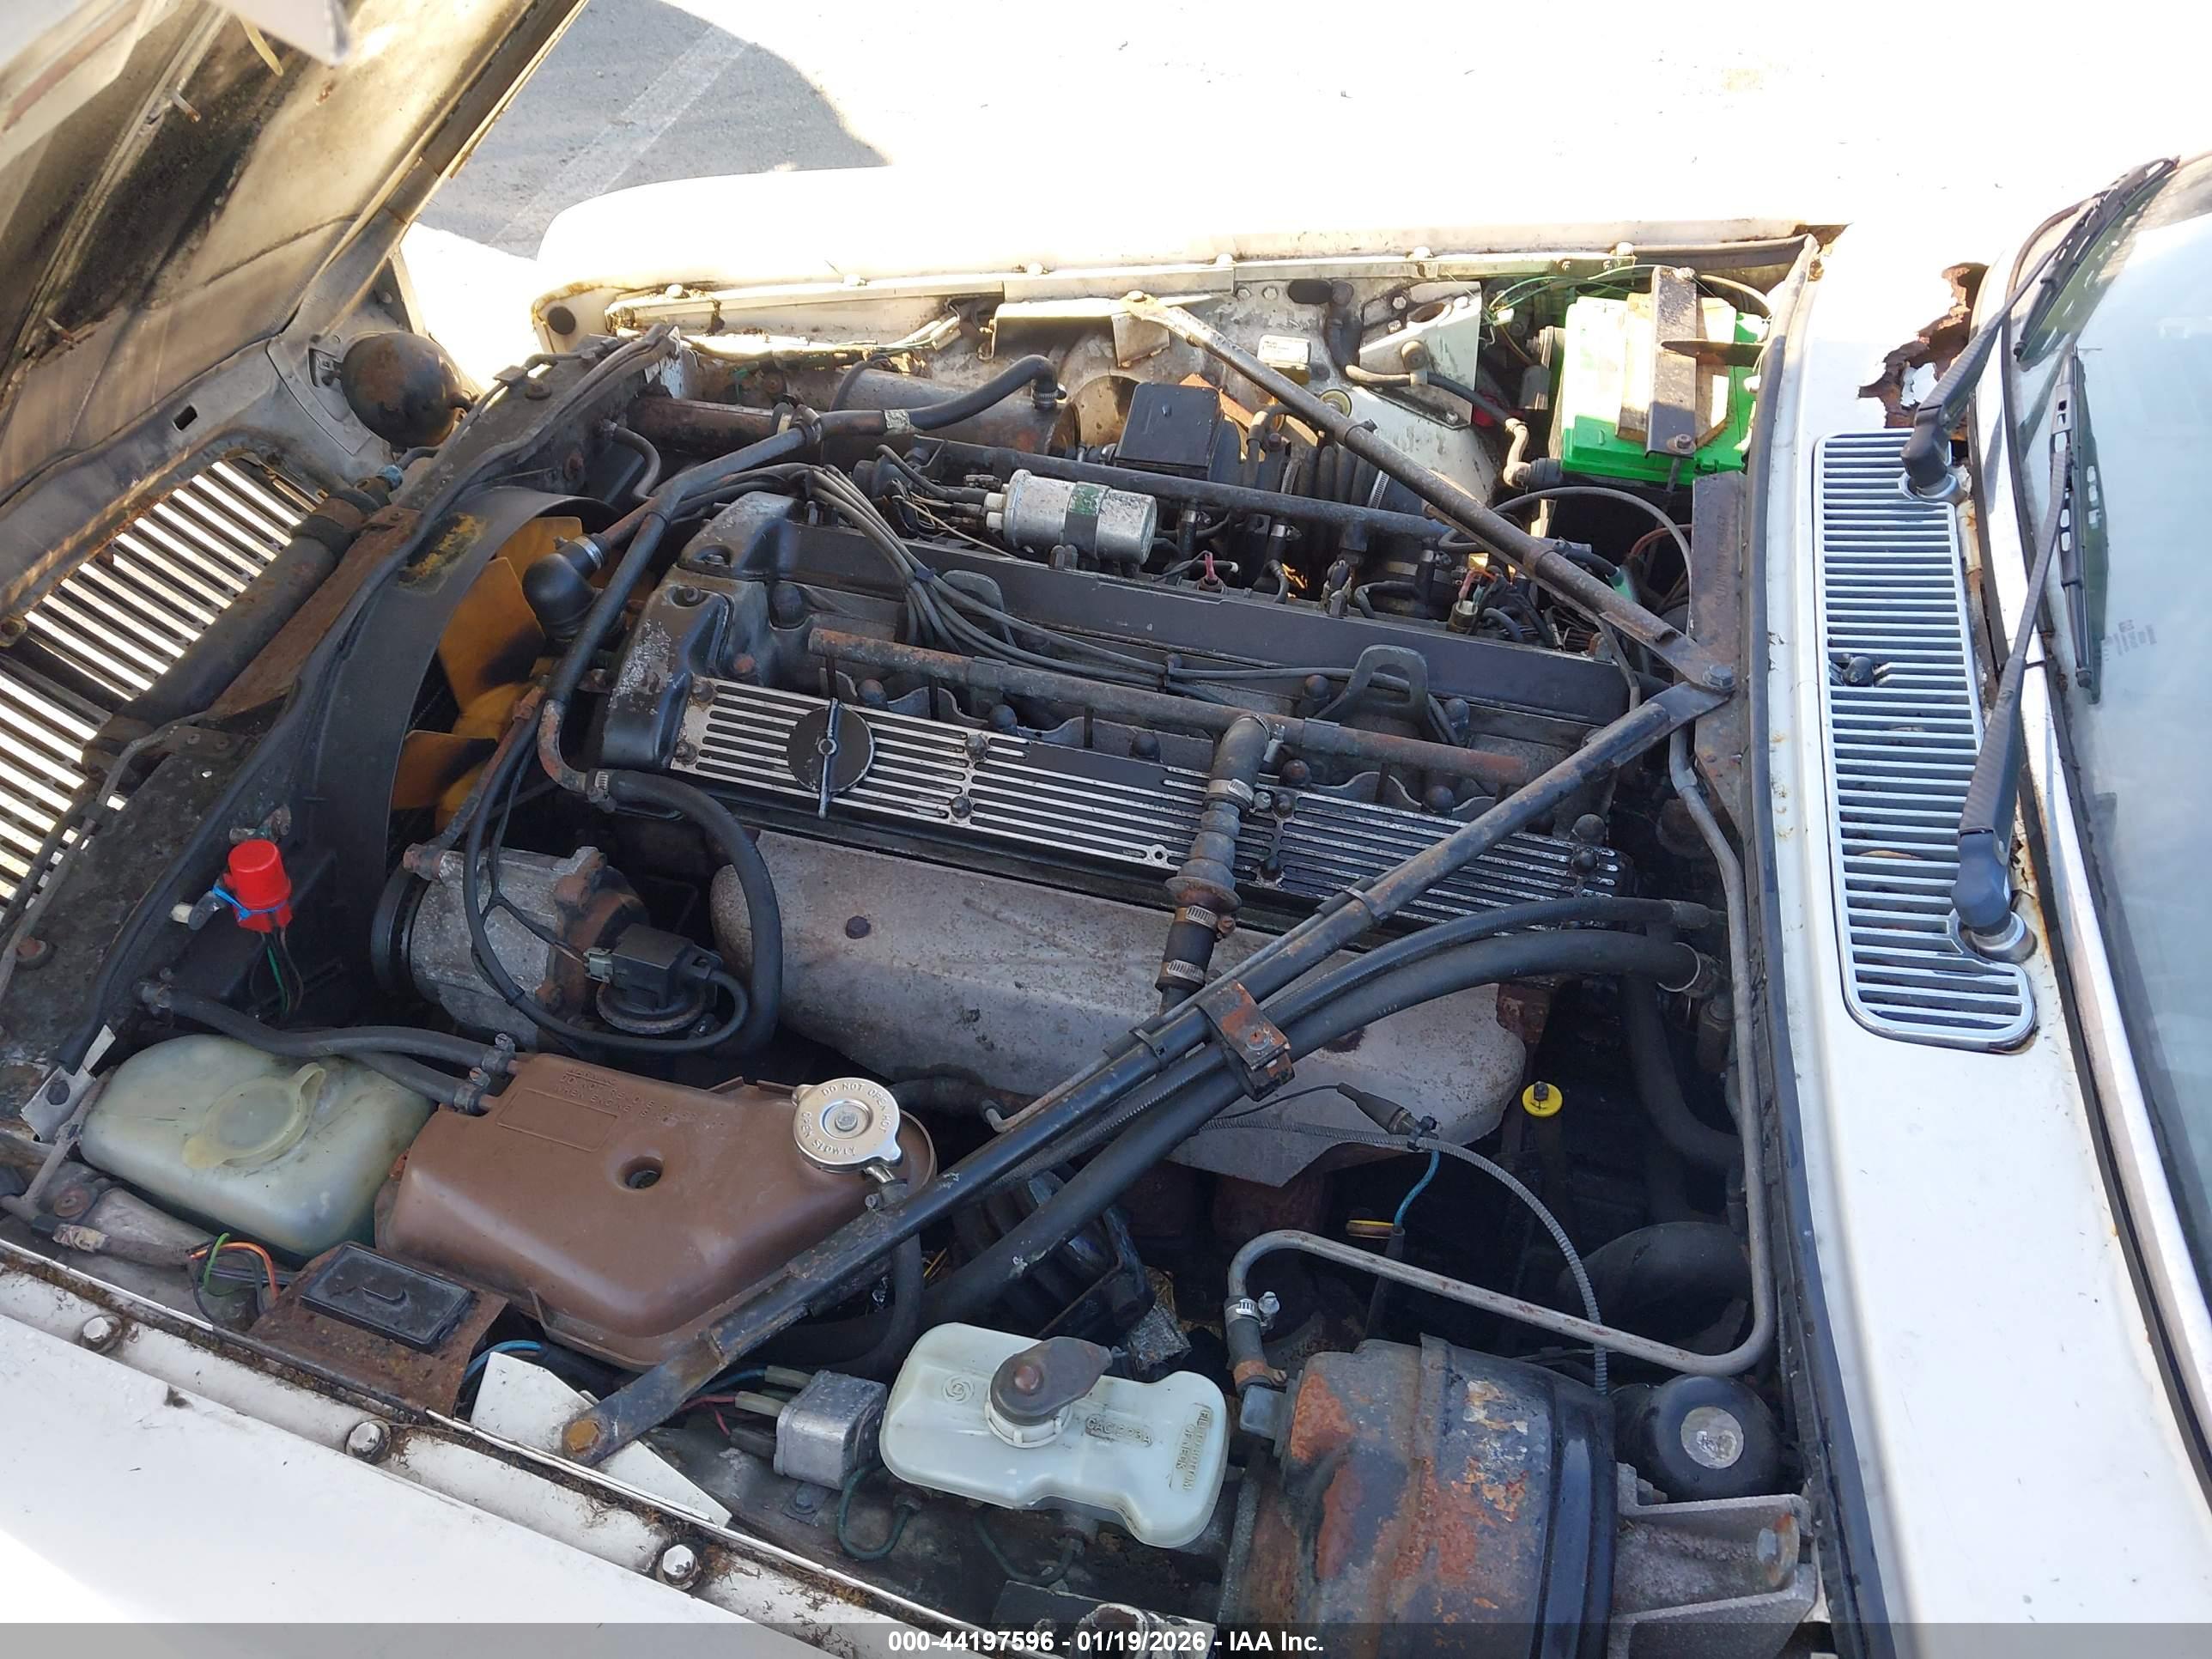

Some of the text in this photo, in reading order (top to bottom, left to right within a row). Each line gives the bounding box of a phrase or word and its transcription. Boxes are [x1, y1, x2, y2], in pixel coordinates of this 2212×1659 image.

[821, 1083, 892, 1133] DO NOT OPEN HOT
[801, 1111, 857, 1157] OPEN SLOWLY
